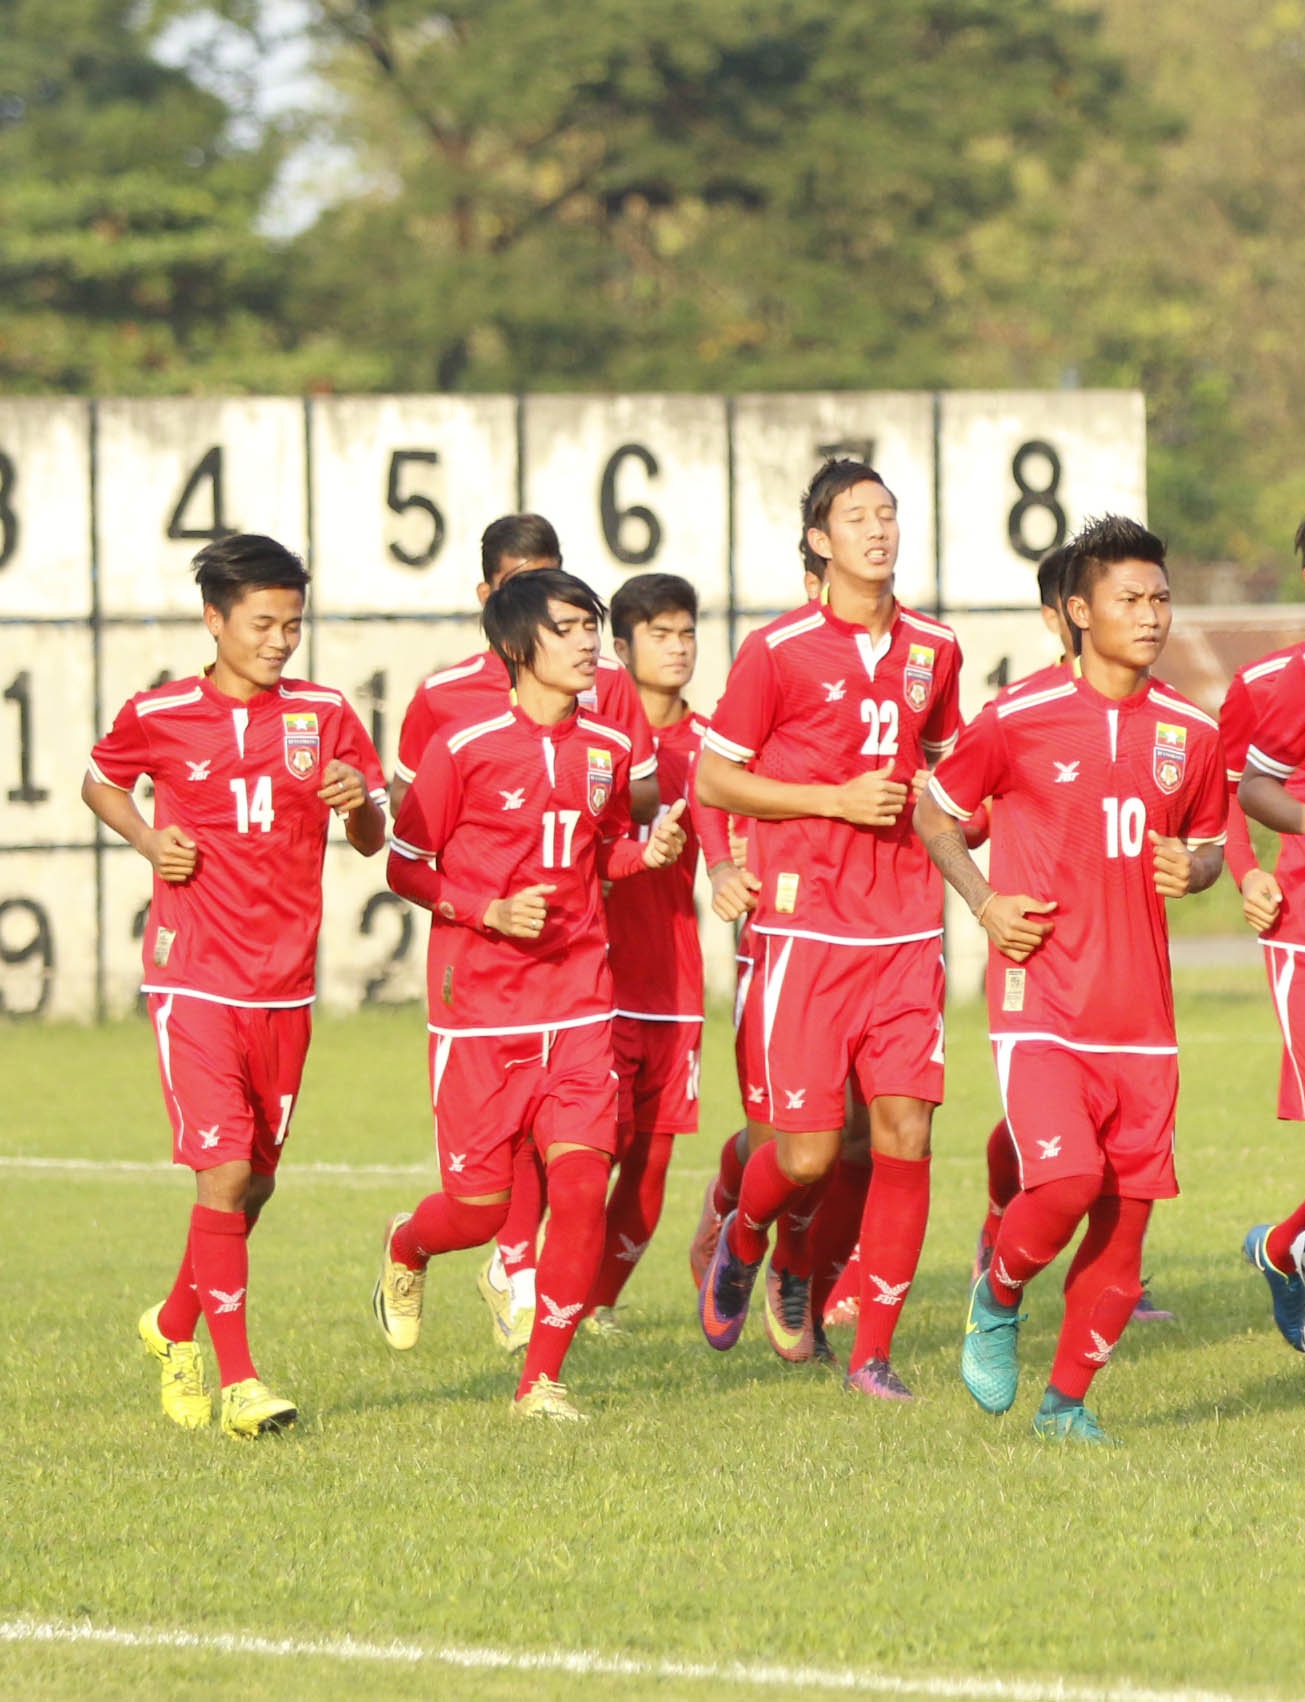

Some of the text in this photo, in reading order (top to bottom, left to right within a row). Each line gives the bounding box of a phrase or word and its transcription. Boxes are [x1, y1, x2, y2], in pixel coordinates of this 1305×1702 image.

[167, 446, 240, 539] 4
[388, 450, 443, 567] 5
[600, 444, 661, 564] 6
[1008, 439, 1066, 562] 8
[860, 698, 899, 756] 22
[229, 776, 275, 834] 14
[543, 809, 582, 869] 17
[1102, 797, 1146, 858] 10
[0, 898, 52, 1020] 9
[358, 890, 413, 1005] 2
